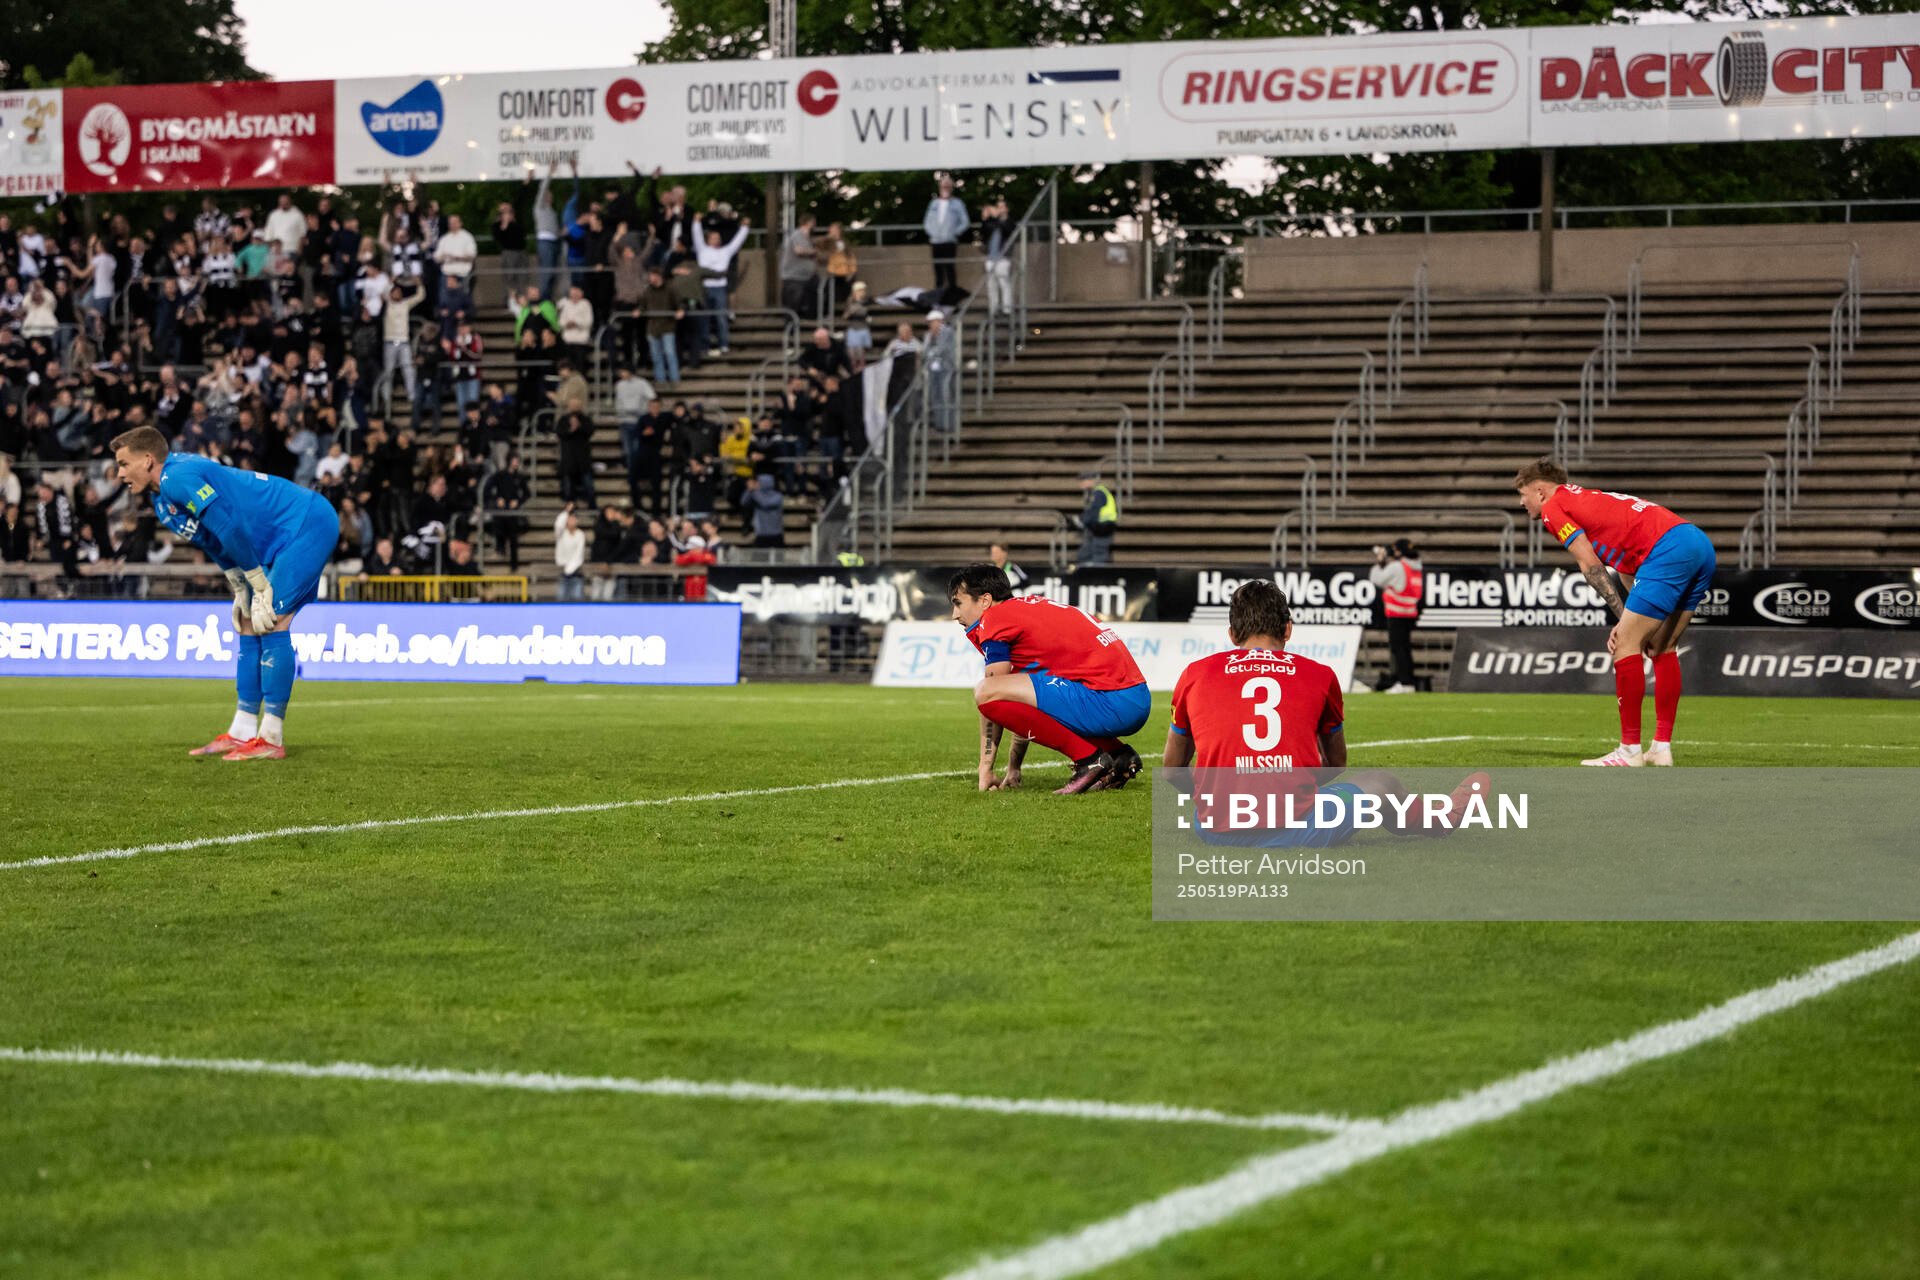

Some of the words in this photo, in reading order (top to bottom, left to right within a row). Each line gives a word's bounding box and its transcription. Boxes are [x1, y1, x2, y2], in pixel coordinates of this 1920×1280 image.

[850, 73, 1015, 92] ADVOKATFIRMAN
[1182, 60, 1499, 105] RINGSERVICE
[1540, 46, 1715, 101] DÄCK
[499, 88, 597, 120] COMFORT
[687, 81, 788, 113] COMFORT
[370, 111, 438, 132] arema
[1216, 127, 1314, 145] PUMPGATAN
[1319, 126, 1329, 142] 6
[1347, 123, 1457, 141] LANDSKRONA
[1557, 522, 1577, 542] XXL
[1198, 571, 1269, 604] He
[1273, 571, 1326, 605] We
[1329, 571, 1376, 606] Go
[1426, 573, 1502, 607] Here
[1504, 573, 1558, 607] We
[1776, 589, 1831, 605] BOD
[1878, 590, 1920, 606] BO
[1290, 608, 1373, 625] ORTRESOR
[1504, 609, 1607, 627] SPORTRESOR
[1776, 604, 1830, 617] BÖRSEN
[176, 614, 234, 661] PÅ:
[1225, 663, 1296, 676] letusplay
[1468, 651, 1655, 675] UNISPO
[1721, 653, 1920, 680] UNISPORT
[1241, 676, 1282, 752] 3
[1235, 755, 1293, 775] NILSSON
